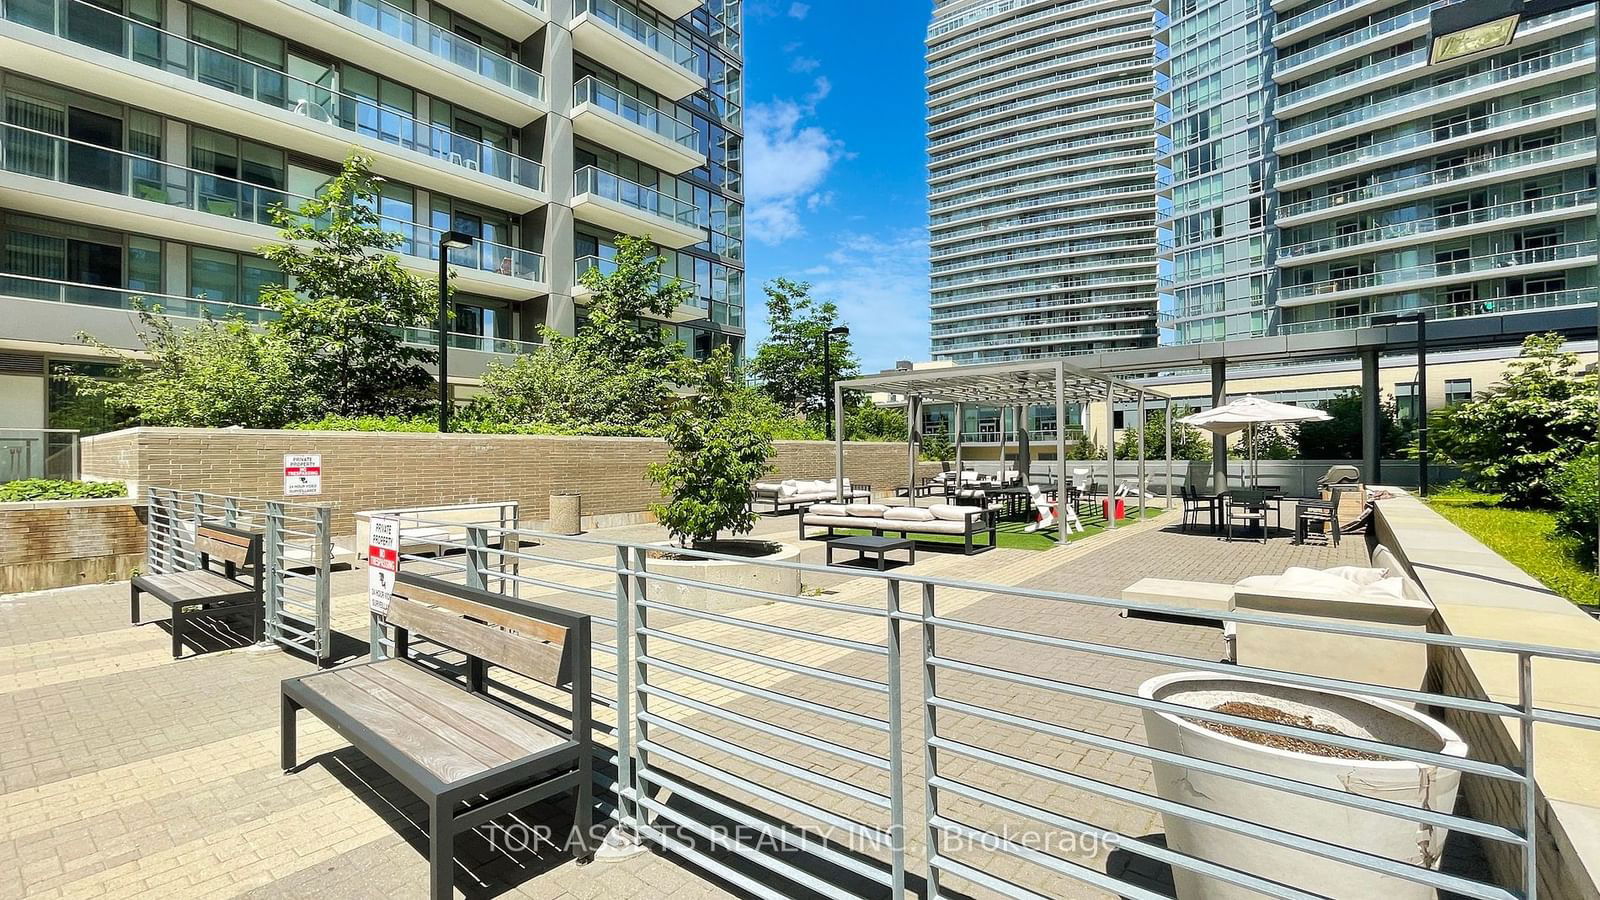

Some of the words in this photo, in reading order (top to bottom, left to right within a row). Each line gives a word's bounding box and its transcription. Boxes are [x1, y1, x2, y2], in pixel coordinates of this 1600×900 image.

[376, 523, 392, 535] PRIVATE
[373, 534, 393, 547] PROPERTY
[370, 555, 395, 570] TRESPASSING
